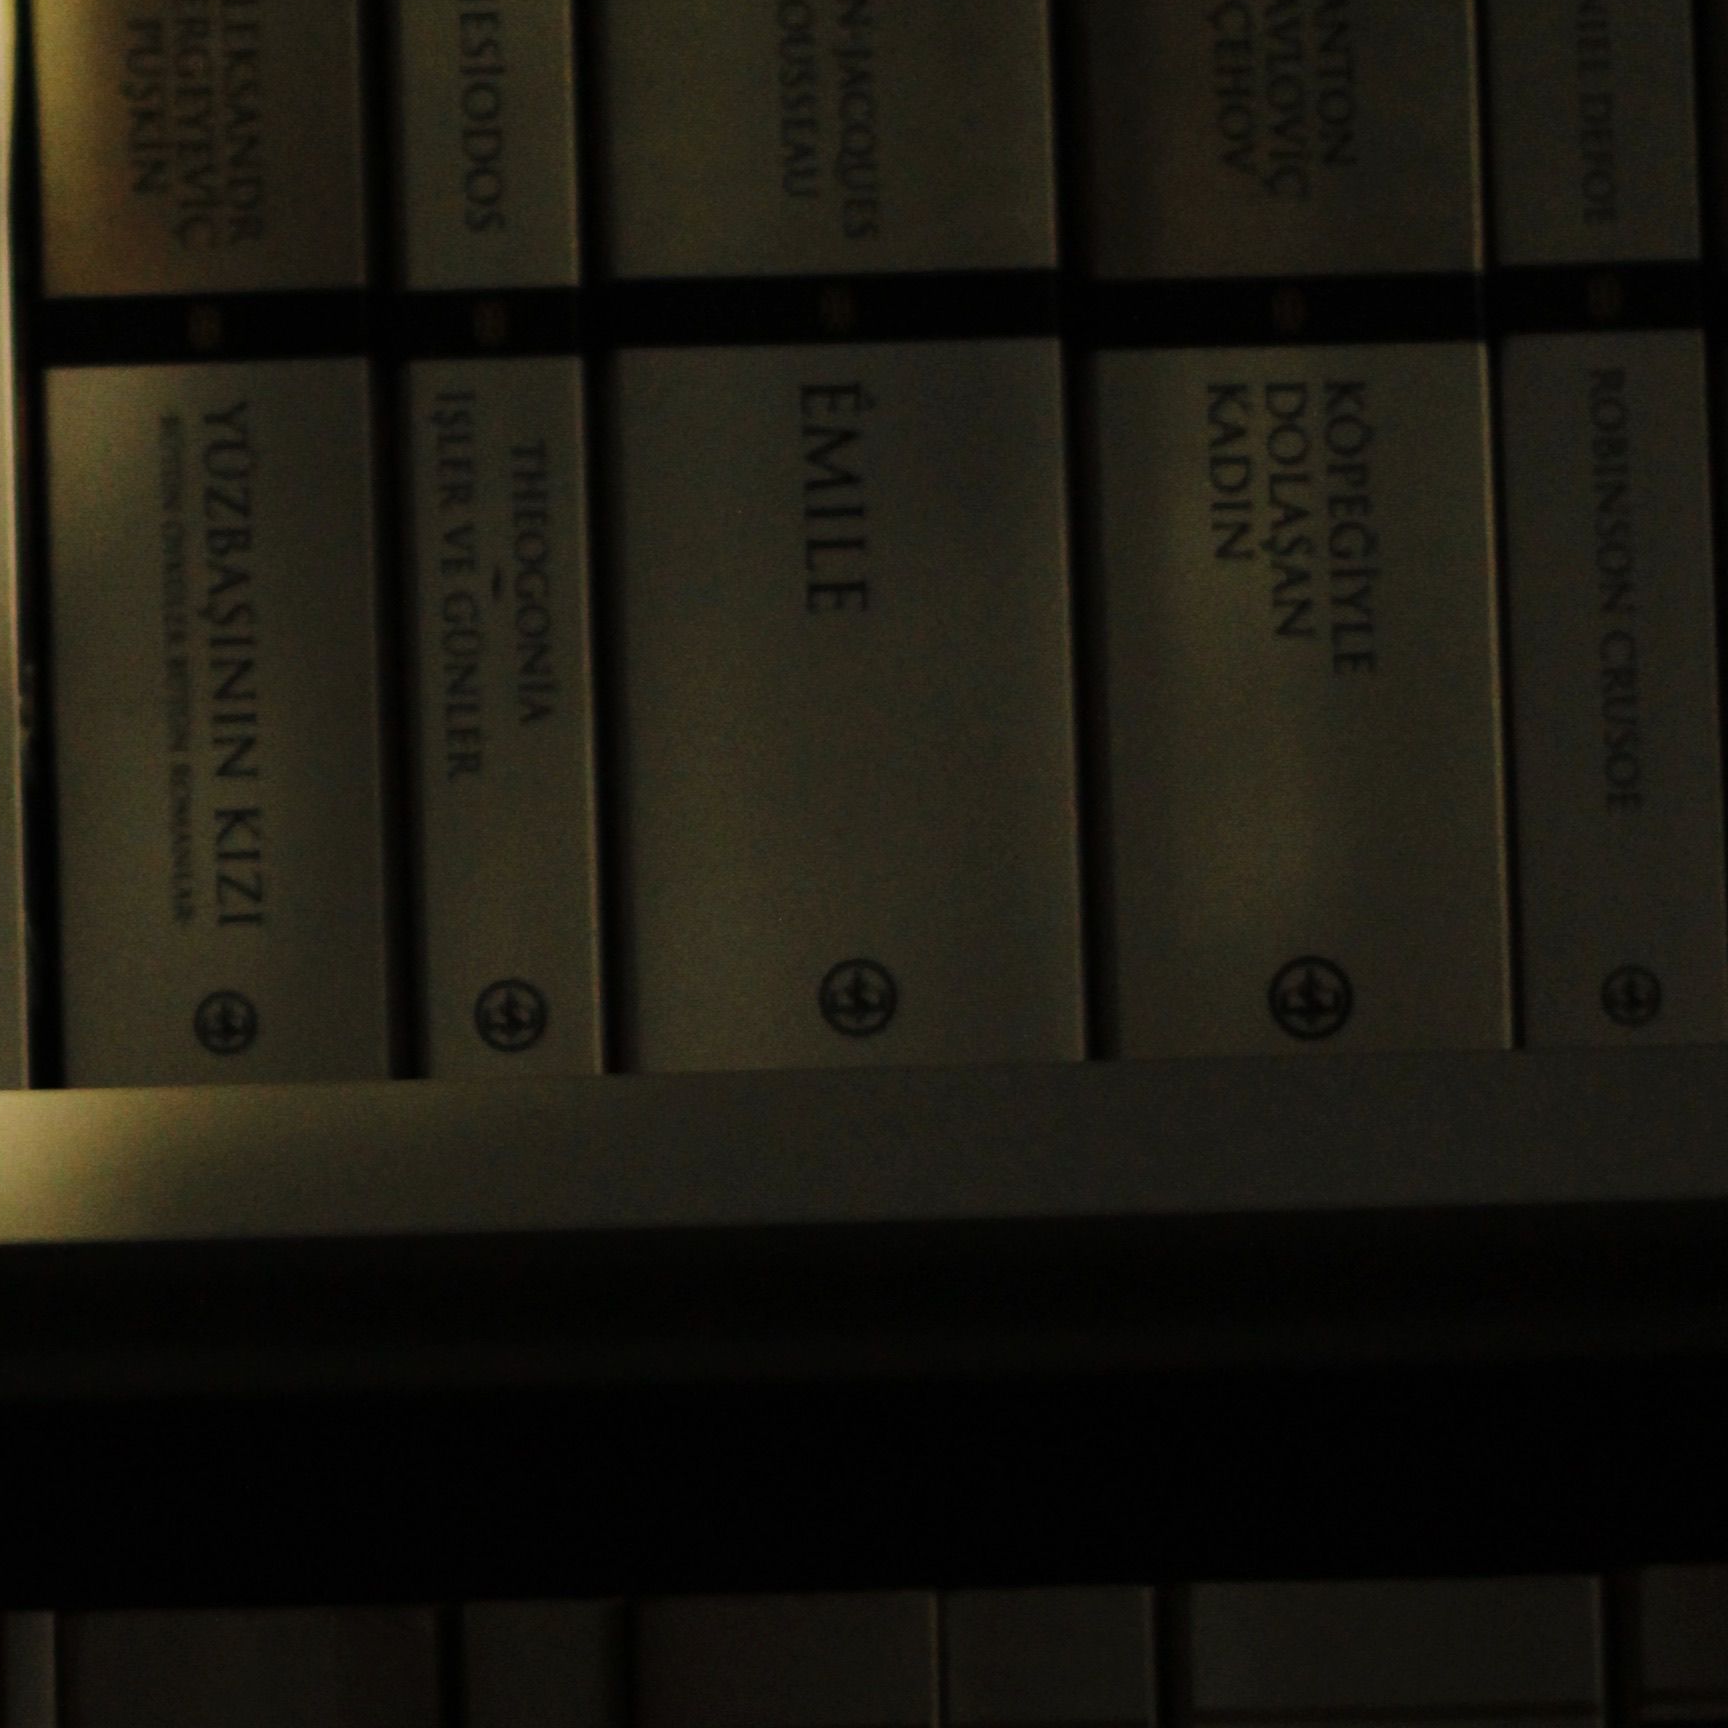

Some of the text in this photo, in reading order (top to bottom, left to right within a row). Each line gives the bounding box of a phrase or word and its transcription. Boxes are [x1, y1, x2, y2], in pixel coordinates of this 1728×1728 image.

[1206, 382, 1255, 563] KADIN
[1260, 382, 1316, 640] DOLAŞAN
[197, 400, 266, 930] YÜZBAŞININ KIZI
